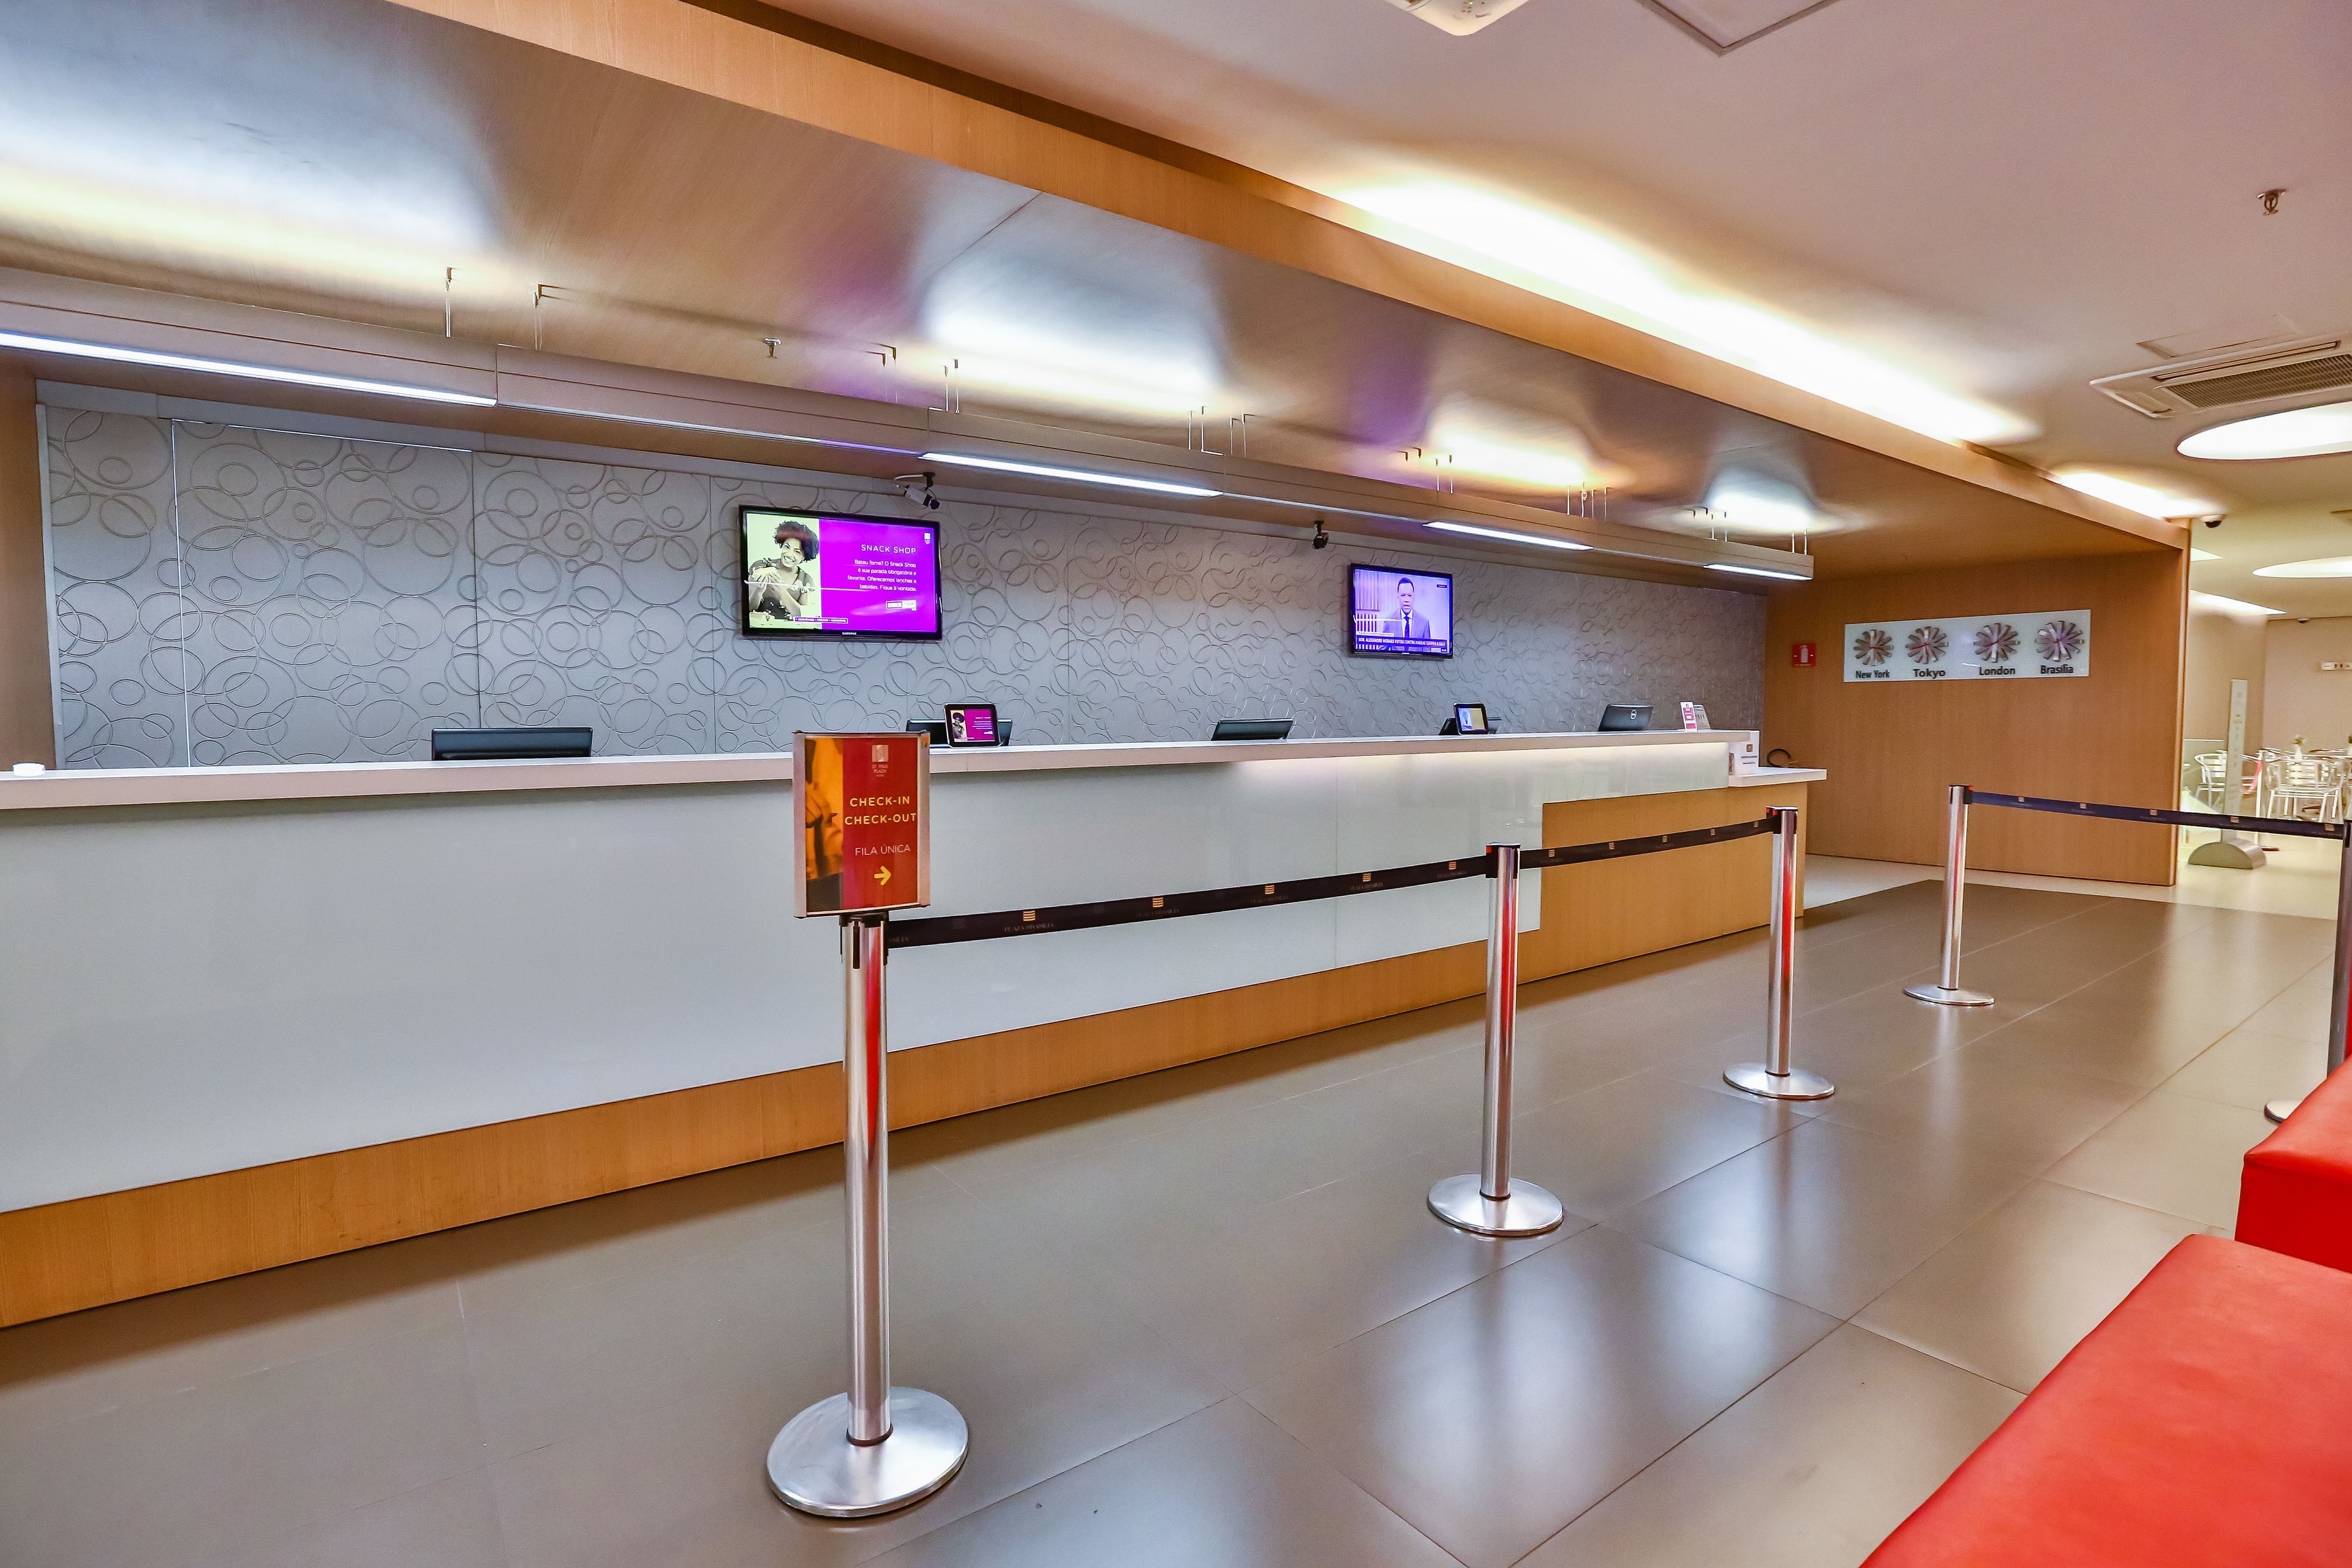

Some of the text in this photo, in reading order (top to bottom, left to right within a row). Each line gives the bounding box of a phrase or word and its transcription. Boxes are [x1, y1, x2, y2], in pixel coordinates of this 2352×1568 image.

[1874, 669, 1890, 678] York
[1913, 668, 1946, 679] Tokyo
[1979, 666, 2016, 676] London
[850, 796, 910, 807] CHECK-IN
[845, 813, 917, 825] CHECK-OUT
[855, 844, 911, 856] FILA ÚNICA
